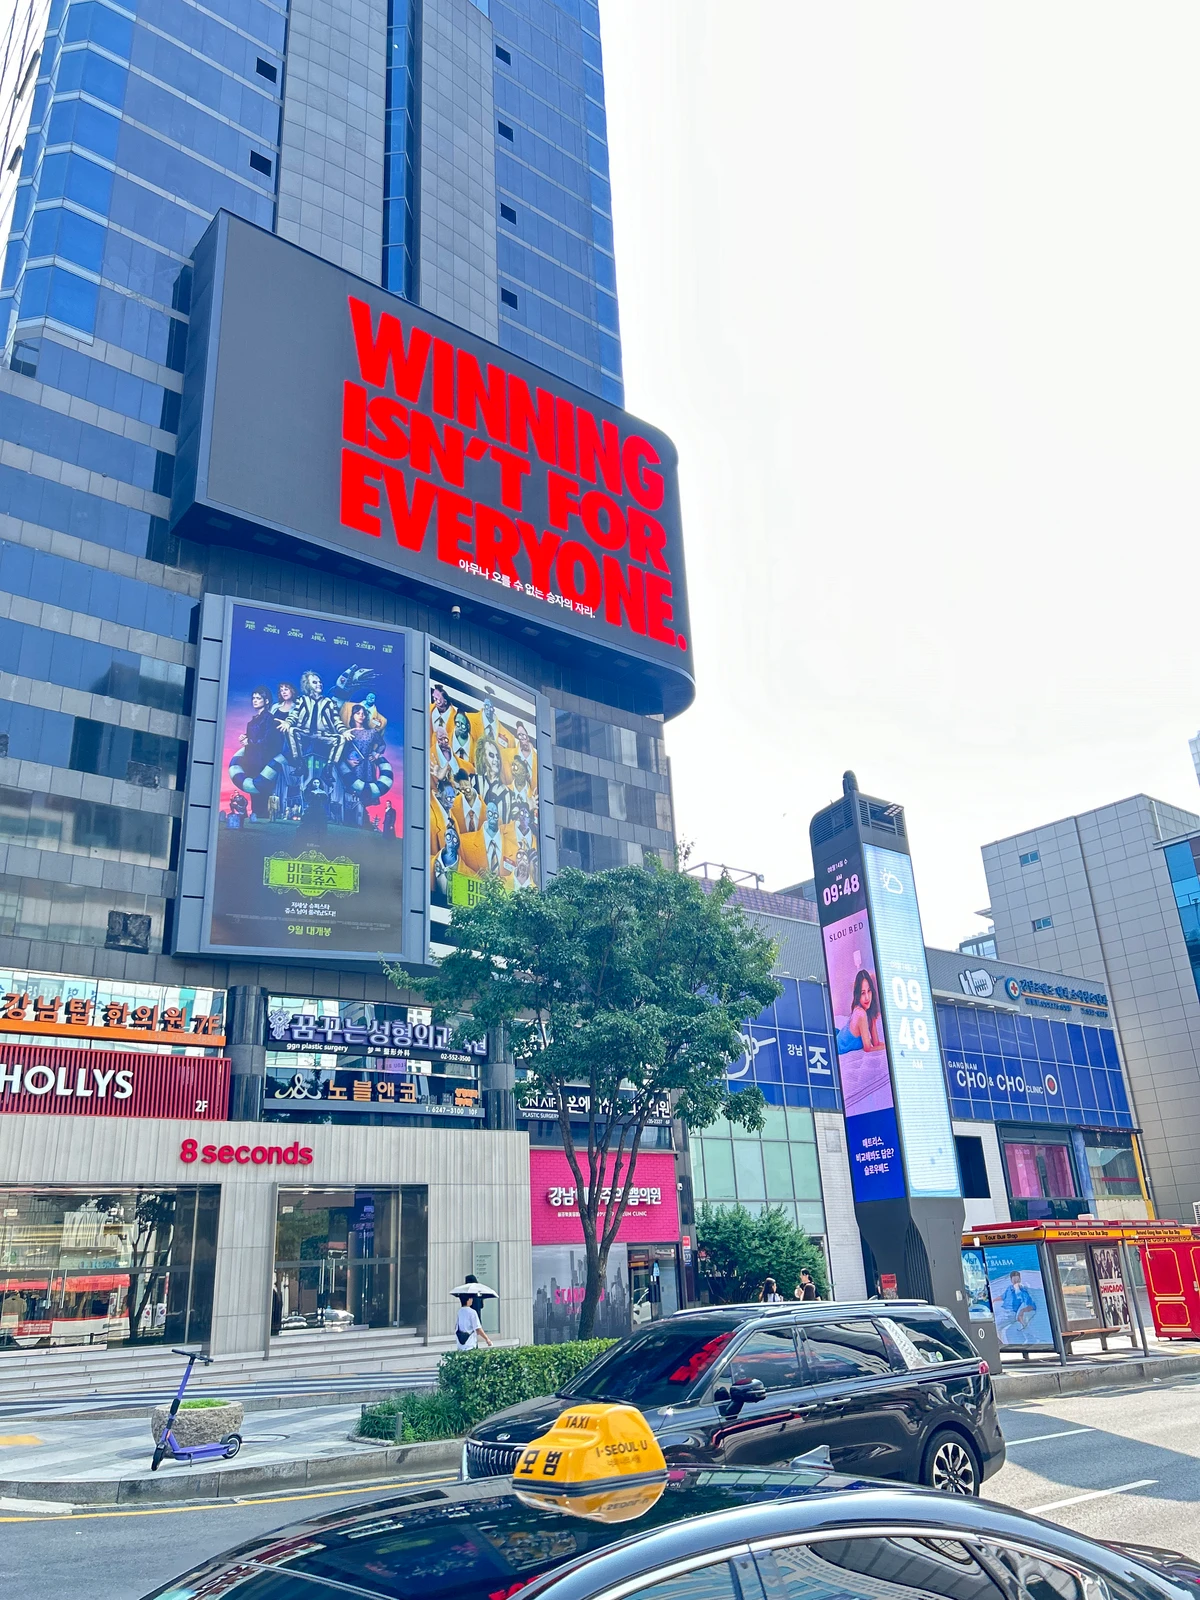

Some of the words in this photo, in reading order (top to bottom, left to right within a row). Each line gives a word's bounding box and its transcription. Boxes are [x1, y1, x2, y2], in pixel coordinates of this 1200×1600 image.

[348, 295, 665, 512] WINNING
[342, 380, 531, 513] ISN'T
[547, 469, 671, 575] FOR
[340, 447, 687, 652] EVERYONE.
[459, 558, 490, 580] 아무나
[491, 571, 512, 589] 오를
[513, 579, 524, 592] 수
[525, 582, 544, 601] 없는
[546, 591, 574, 611] 승자의
[575, 601, 596, 619] 자리.
[823, 874, 860, 906] 09:48
[287, 924, 304, 935] 9월
[306, 926, 332, 937] 대개봉
[829, 929, 847, 942] SLOU
[849, 921, 864, 935] BED
[891, 976, 923, 1012] 09
[3, 992, 94, 1025] 강남탑
[106, 1001, 187, 1033] 한의원
[195, 1015, 220, 1035] 7F
[898, 1016, 930, 1052] 48
[286, 1042, 300, 1052] ggn
[301, 1042, 323, 1051] plastic
[324, 1044, 348, 1053] surgery
[440, 1053, 471, 1062] 02-552-3500
[787, 1044, 803, 1057] 강남
[0, 1063, 134, 1099] HOLLYS
[327, 1079, 417, 1104] 노블앤코
[956, 1070, 987, 1089] CHO
[988, 1076, 994, 1086] &
[996, 1074, 1025, 1093] CHO
[1026, 1085, 1044, 1095] CLINIC
[195, 1100, 209, 1113] 2F
[432, 1107, 464, 1115] 6247-3100
[1100, 1284, 1124, 1294] CHICAGO
[565, 1416, 590, 1429] TAXI
